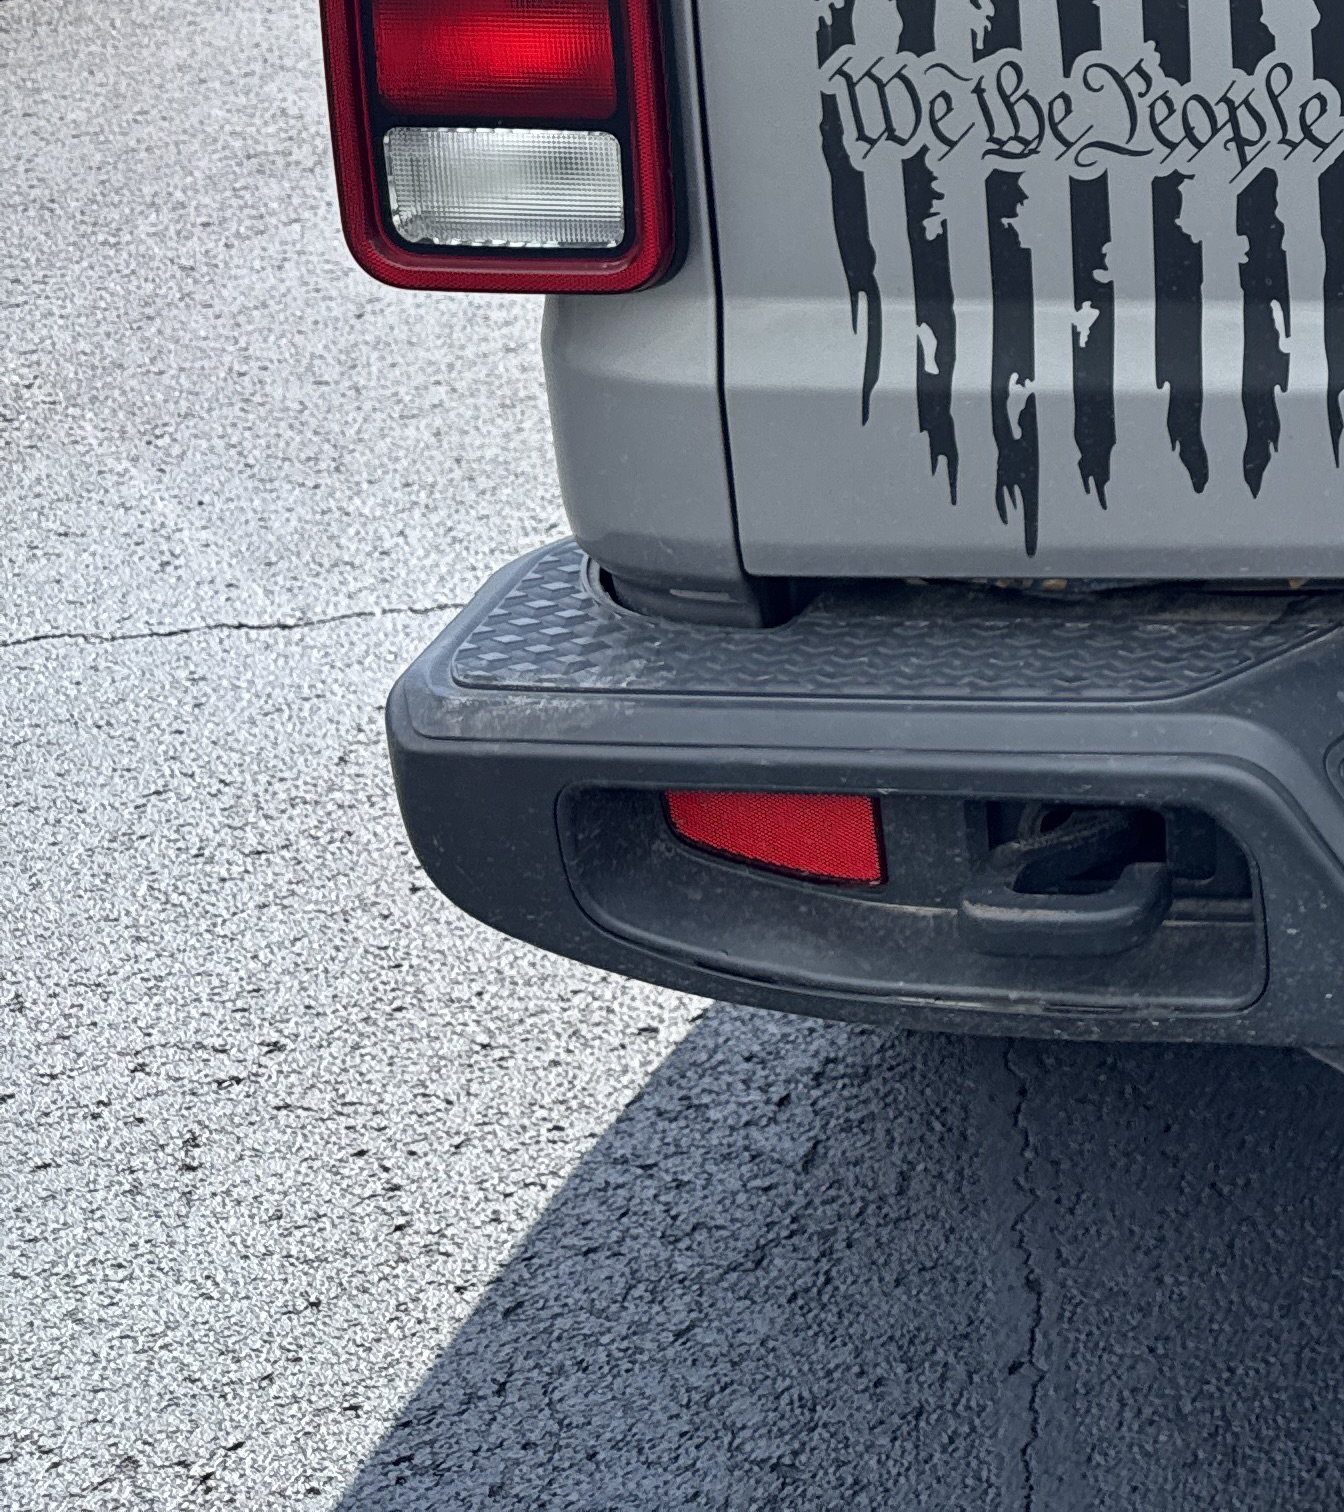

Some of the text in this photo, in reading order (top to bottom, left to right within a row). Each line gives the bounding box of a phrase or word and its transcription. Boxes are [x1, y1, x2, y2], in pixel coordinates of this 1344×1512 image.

[829, 55, 1344, 184] We the People
